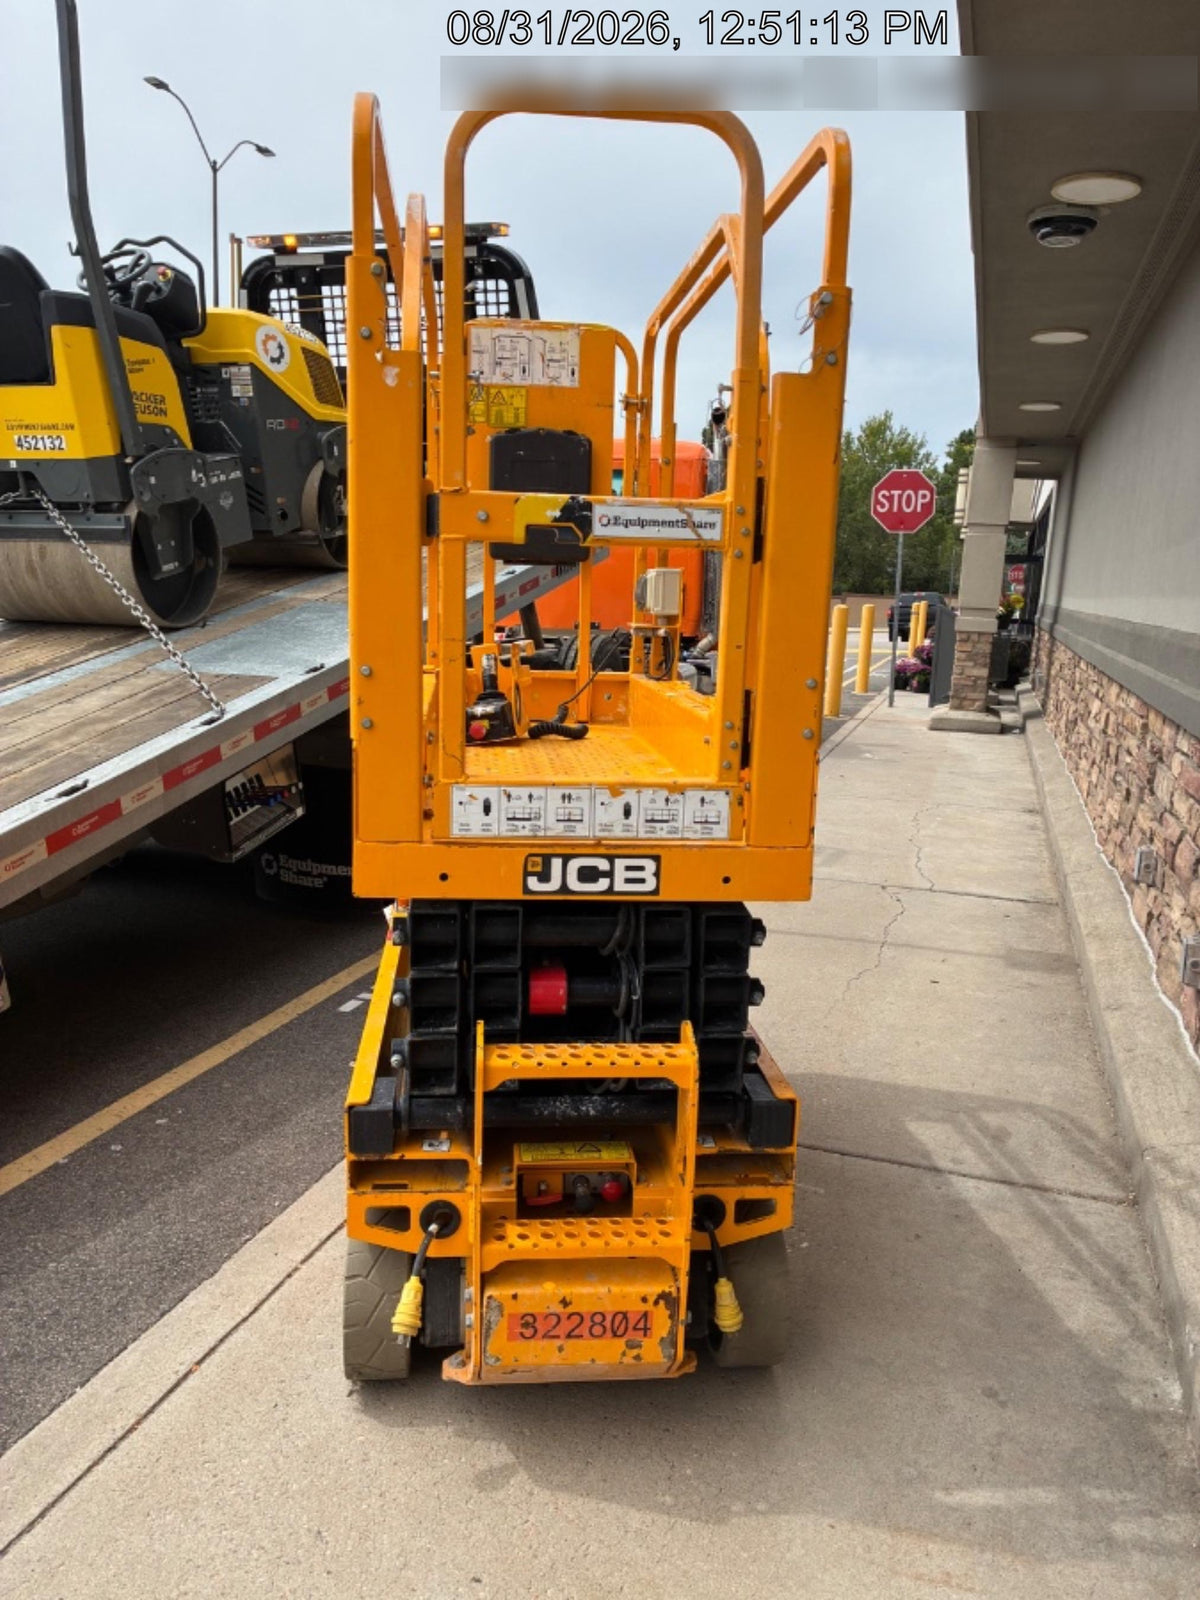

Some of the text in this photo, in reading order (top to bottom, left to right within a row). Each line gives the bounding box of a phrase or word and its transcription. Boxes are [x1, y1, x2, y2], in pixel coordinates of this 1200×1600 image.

[16, 435, 65, 450] 452132
[876, 489, 931, 513] STOP
[280, 853, 352, 877] Equipme
[526, 856, 657, 892] JCB
[519, 1311, 652, 1340] 322804
